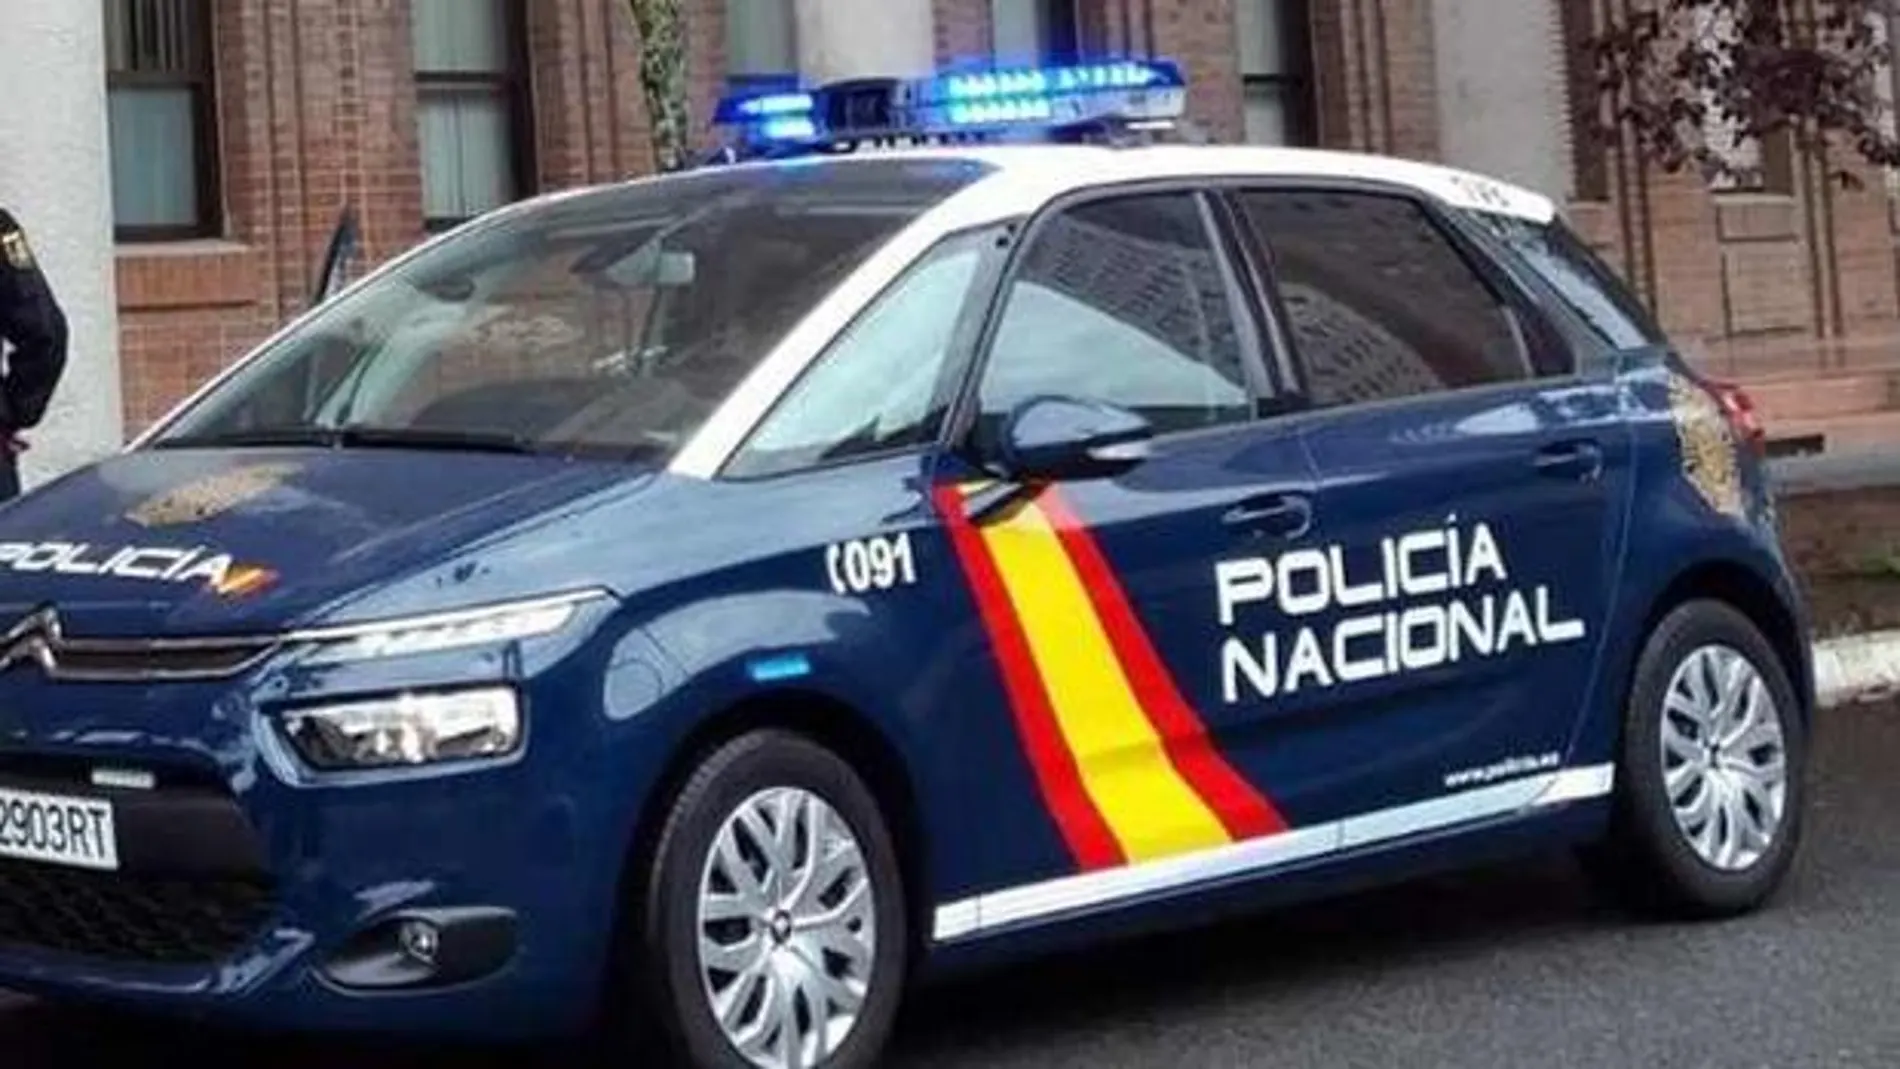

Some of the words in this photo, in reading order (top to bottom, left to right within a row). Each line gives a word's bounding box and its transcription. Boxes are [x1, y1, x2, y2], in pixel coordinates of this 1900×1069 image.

[845, 532, 916, 592] 091
[1215, 513, 1506, 625] POLICÍA
[1221, 586, 1585, 703] NACIONAL
